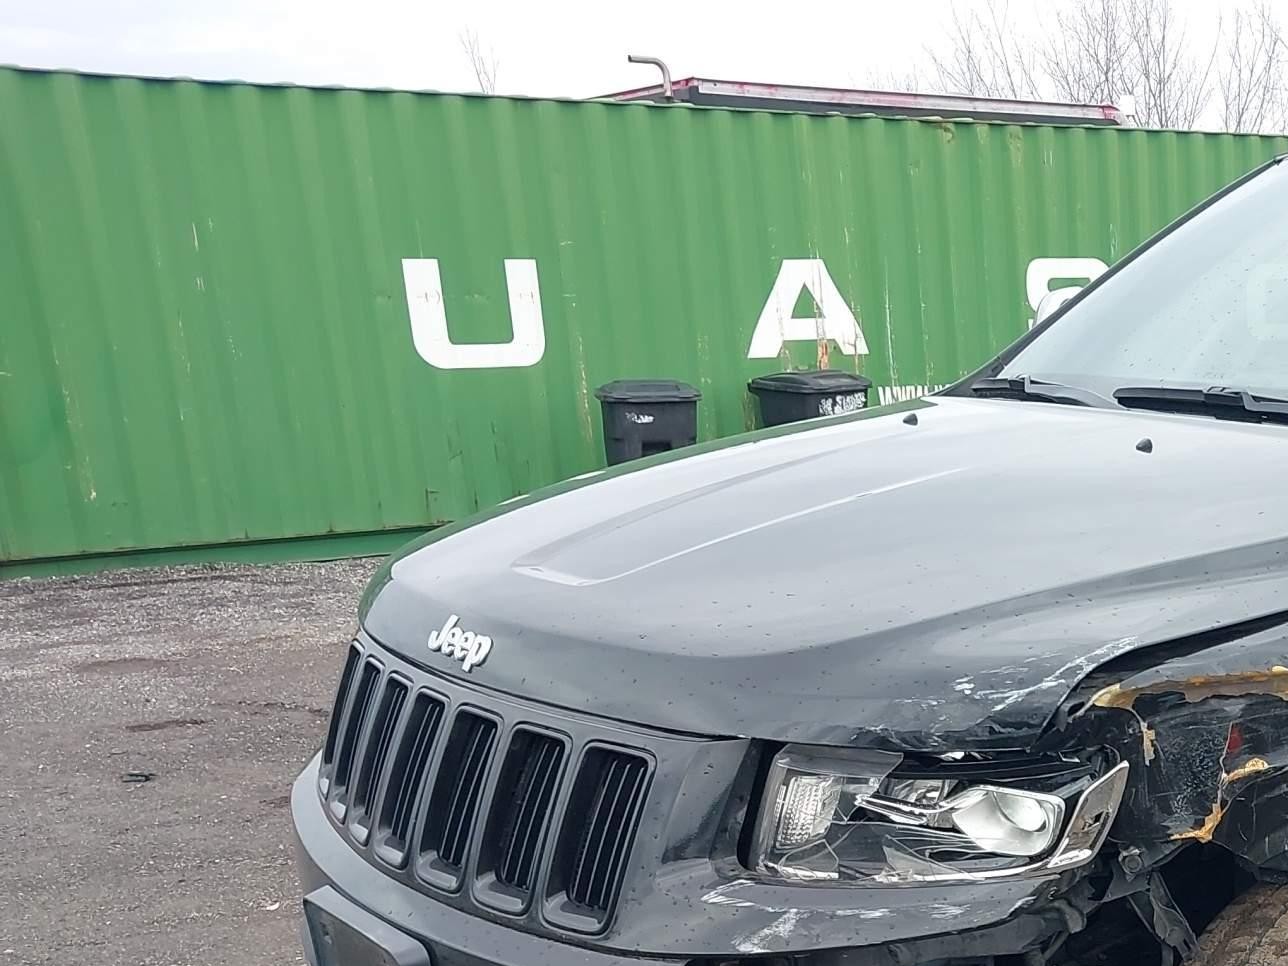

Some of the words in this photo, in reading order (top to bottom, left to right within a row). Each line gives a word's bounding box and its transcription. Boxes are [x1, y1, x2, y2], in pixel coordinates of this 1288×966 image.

[401, 257, 546, 370] U
[747, 257, 870, 359] A
[427, 614, 493, 673] Jeep
